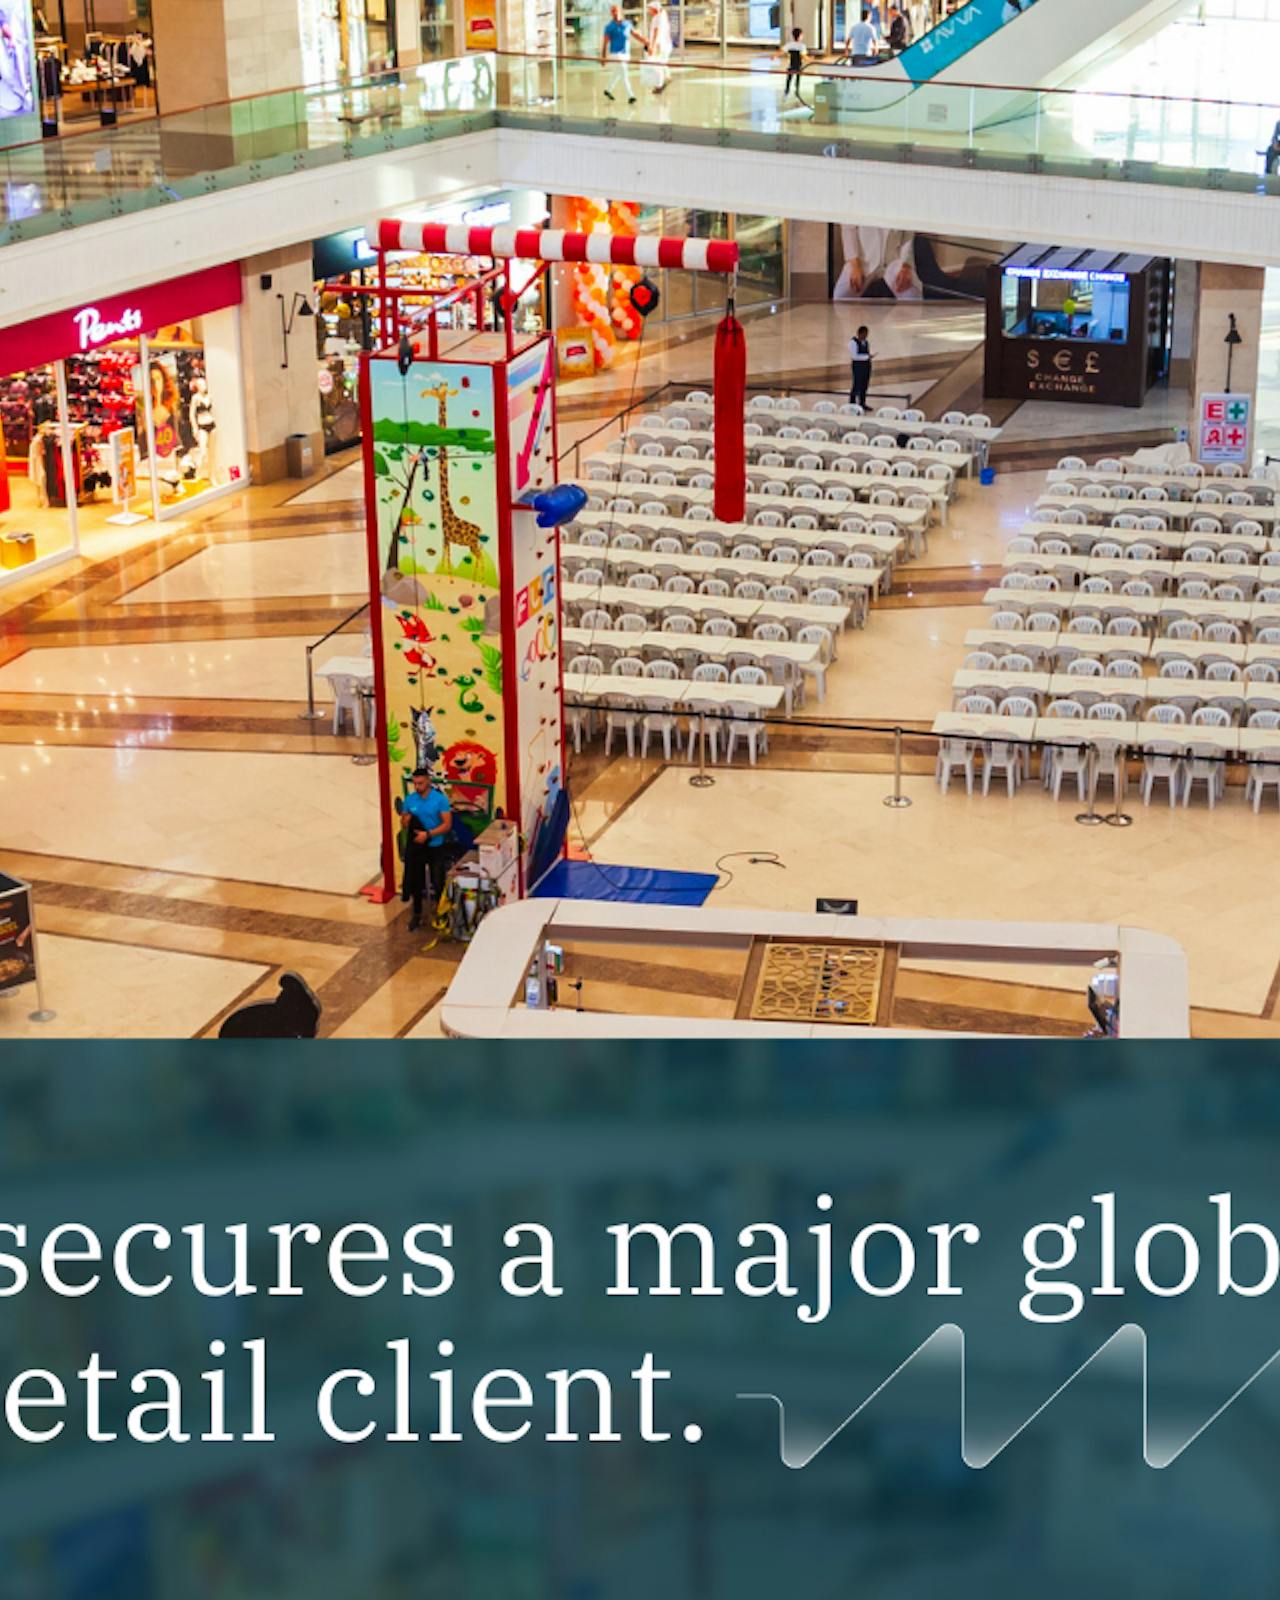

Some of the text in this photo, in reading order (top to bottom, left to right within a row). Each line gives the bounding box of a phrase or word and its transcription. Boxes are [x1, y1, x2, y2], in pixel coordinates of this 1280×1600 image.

[935, 5, 983, 45] AVVA
[1034, 373, 1084, 383] CHANGE
[1028, 381, 1096, 393] EXCHANGE
